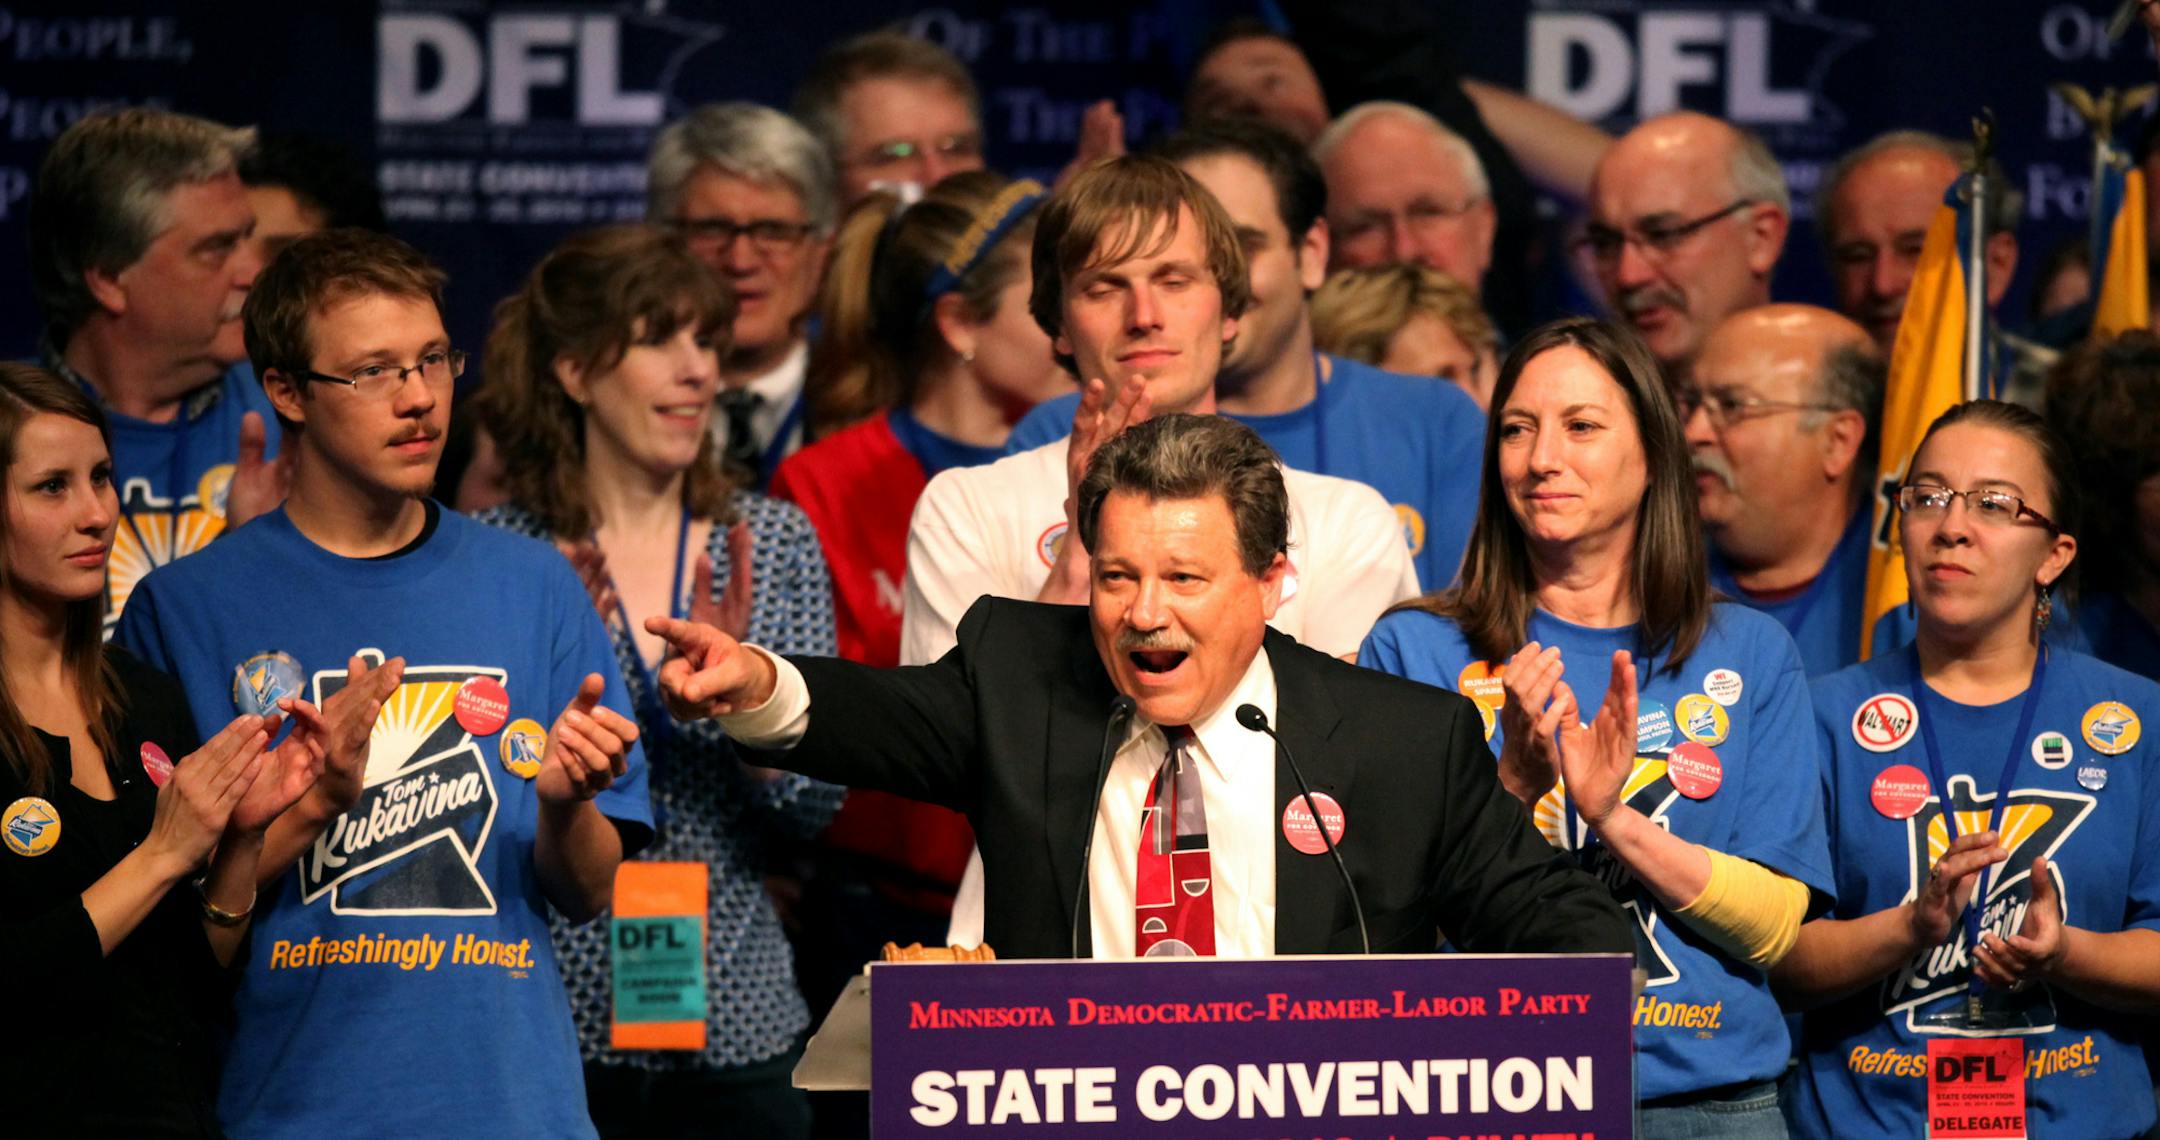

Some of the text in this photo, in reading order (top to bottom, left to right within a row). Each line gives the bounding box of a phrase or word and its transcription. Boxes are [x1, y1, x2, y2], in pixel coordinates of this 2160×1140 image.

[378, 13, 665, 126] DFL
[1527, 10, 1813, 123] DFL
[1464, 678, 1503, 688] RUKAVI
[458, 688, 508, 713] Margaret
[1637, 711, 1666, 725] AVINA
[1672, 752, 1721, 774] Margaret
[382, 774, 425, 807] Tom
[1875, 779, 1928, 792] Margaret
[311, 772, 482, 884] Rukavina
[1287, 810, 1341, 827] Marret
[1980, 899, 2007, 928] om
[619, 924, 686, 949] DFL
[270, 933, 446, 971] Refreshingly
[1632, 996, 1722, 1029] Honest.
[1849, 1045, 1928, 1078] Refres
[1935, 1056, 2006, 1083] DFL
[909, 1055, 1593, 1127] STATE CONVENTION
[1934, 1115, 2022, 1131] DELEGATE
